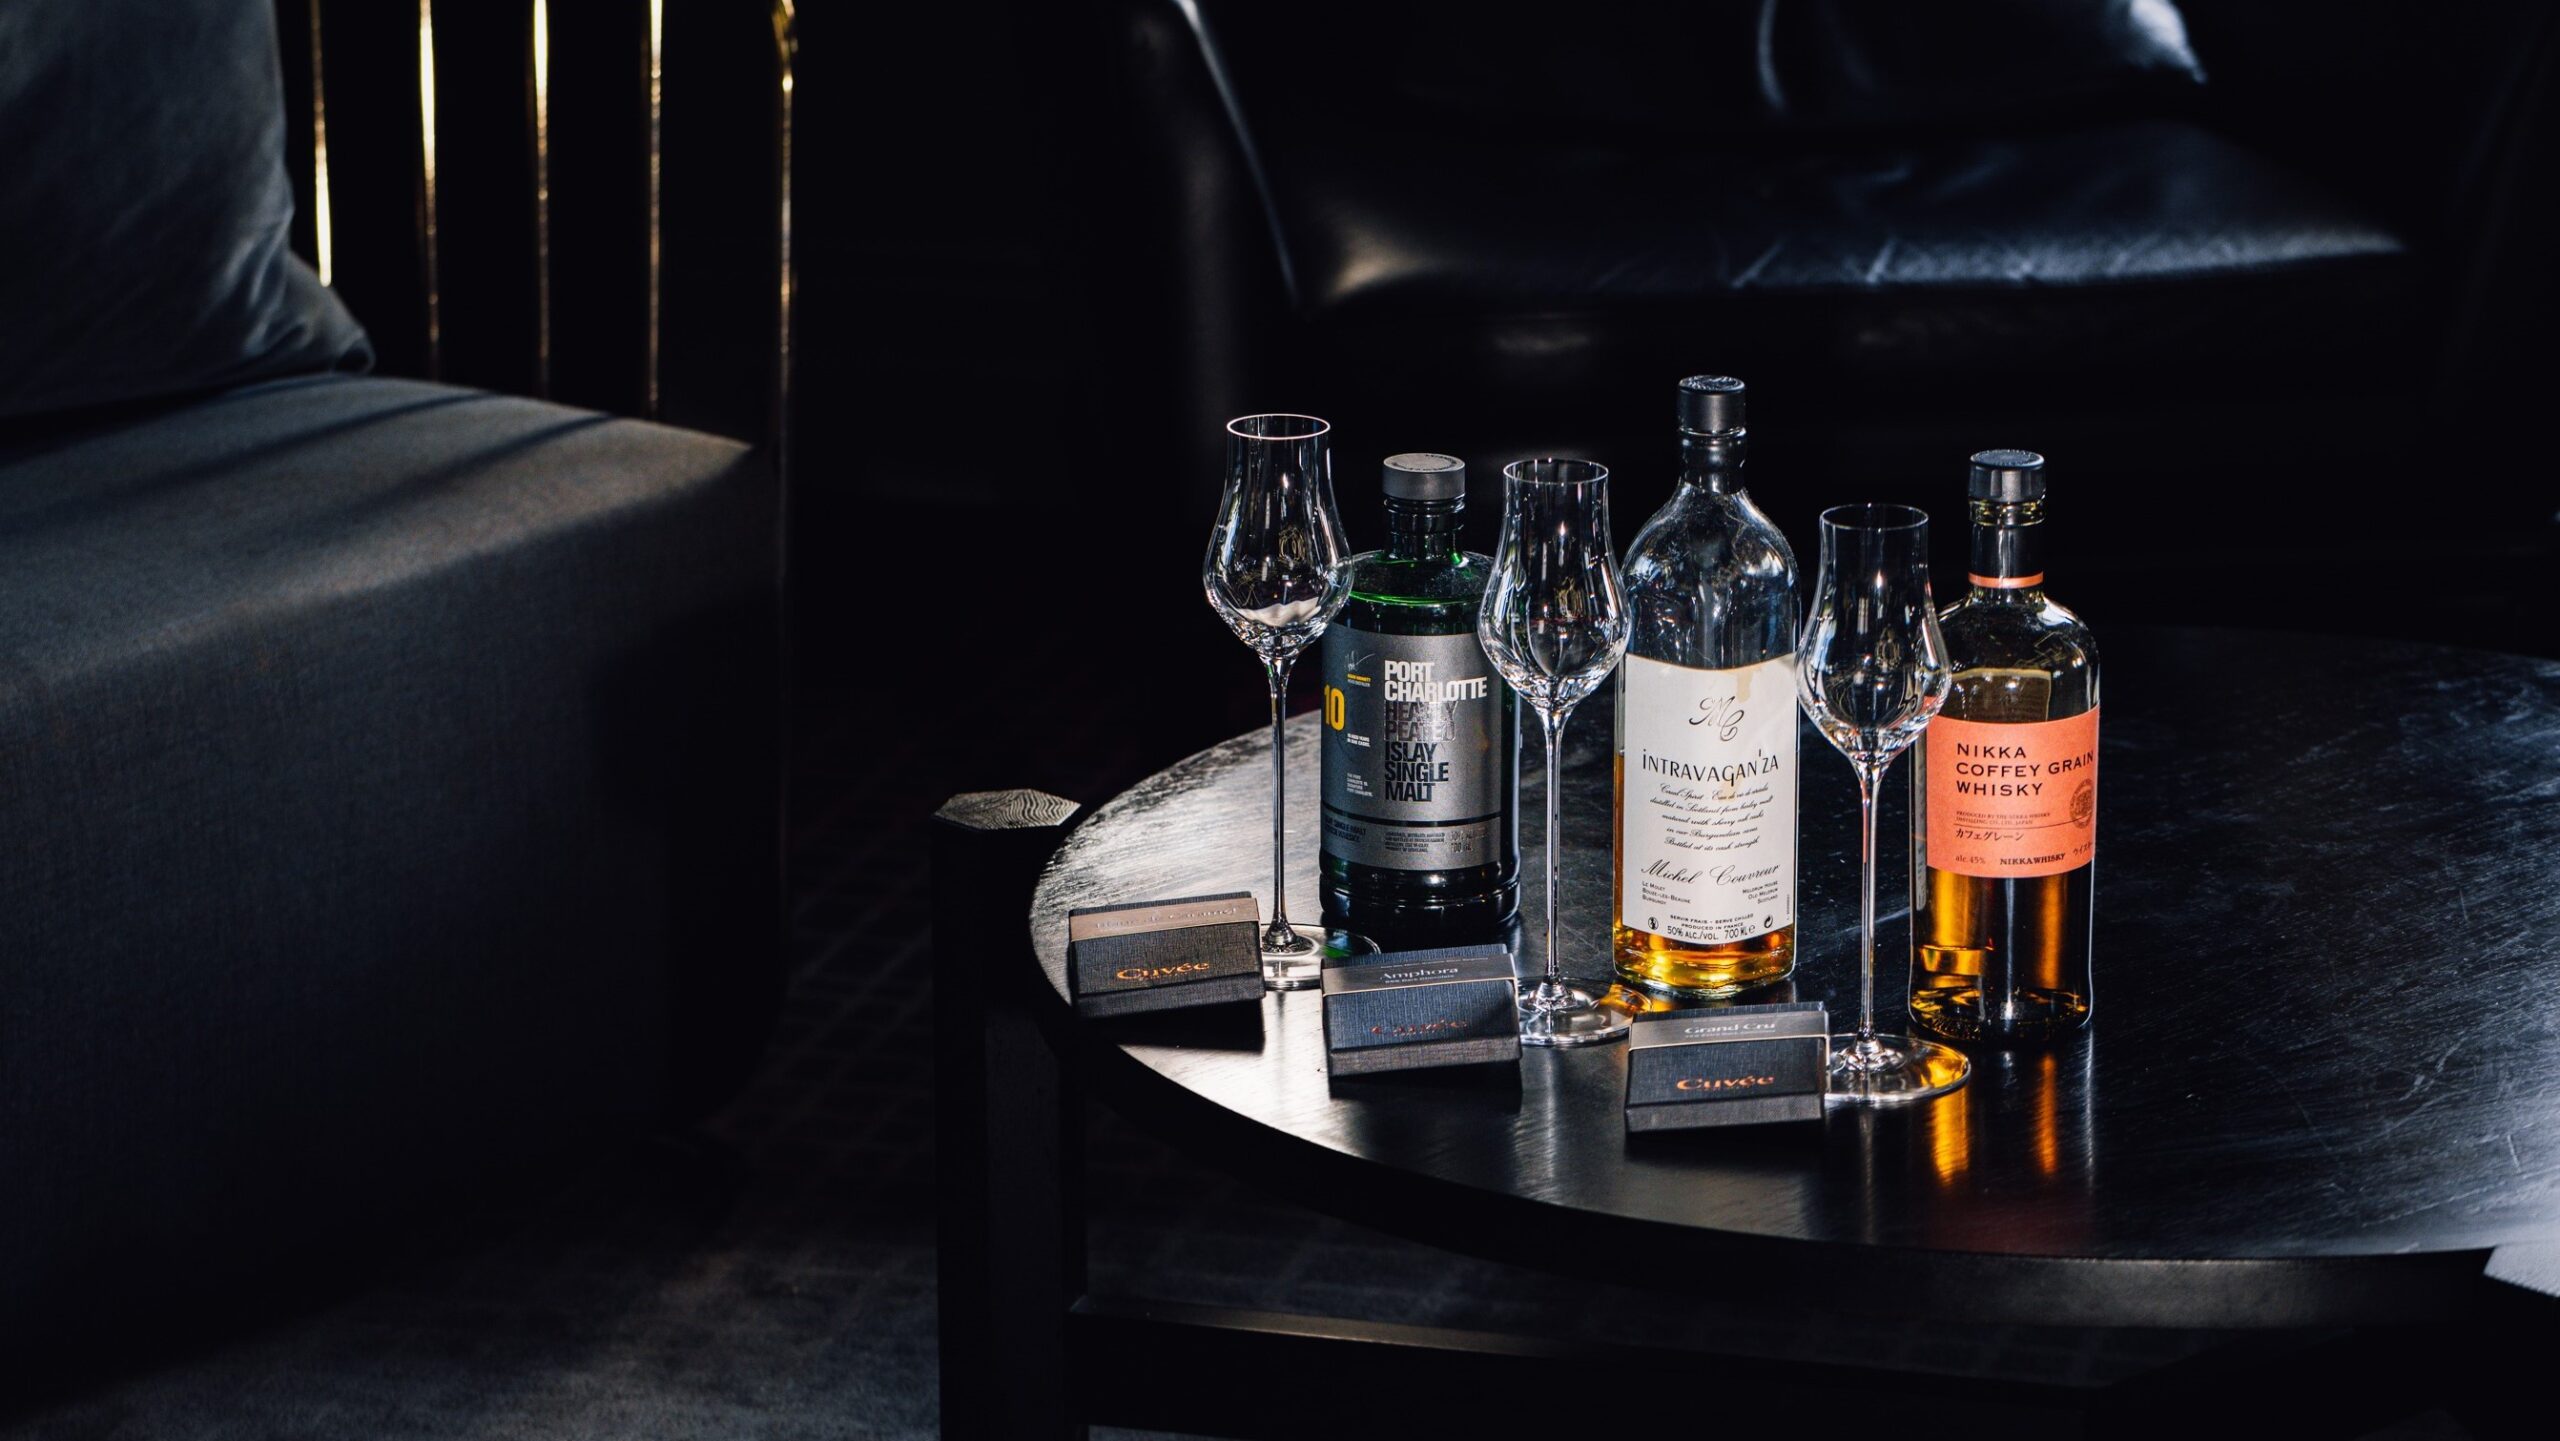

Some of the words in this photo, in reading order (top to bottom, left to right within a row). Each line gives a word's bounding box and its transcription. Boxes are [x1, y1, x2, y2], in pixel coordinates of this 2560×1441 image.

[1384, 660, 1435, 682] PORT
[1384, 676, 1488, 704] CHARLOTTE
[1324, 684, 1345, 731] 10
[1385, 741, 1437, 762] ISLAY
[1957, 743, 2027, 759] NIKKA
[1384, 761, 1449, 782] SINGLE
[1956, 762, 2040, 777] COFFEY
[2048, 750, 2094, 775] GRAIN
[1385, 781, 1436, 802] MALT
[1956, 781, 2043, 797] WHISKY
[1691, 818, 1709, 826] with
[1956, 828, 2024, 841] カフェグレーン
[1640, 859, 1704, 885] Michel
[1709, 864, 1780, 886] Couvreur
[1667, 925, 1684, 937] 50%
[1724, 929, 1739, 940] 700
[1681, 923, 1713, 931] PRODUCED
[1380, 967, 1459, 979] Amphora
[1684, 1023, 1738, 1034] Grand
[1743, 1022, 1775, 1030] Cru
